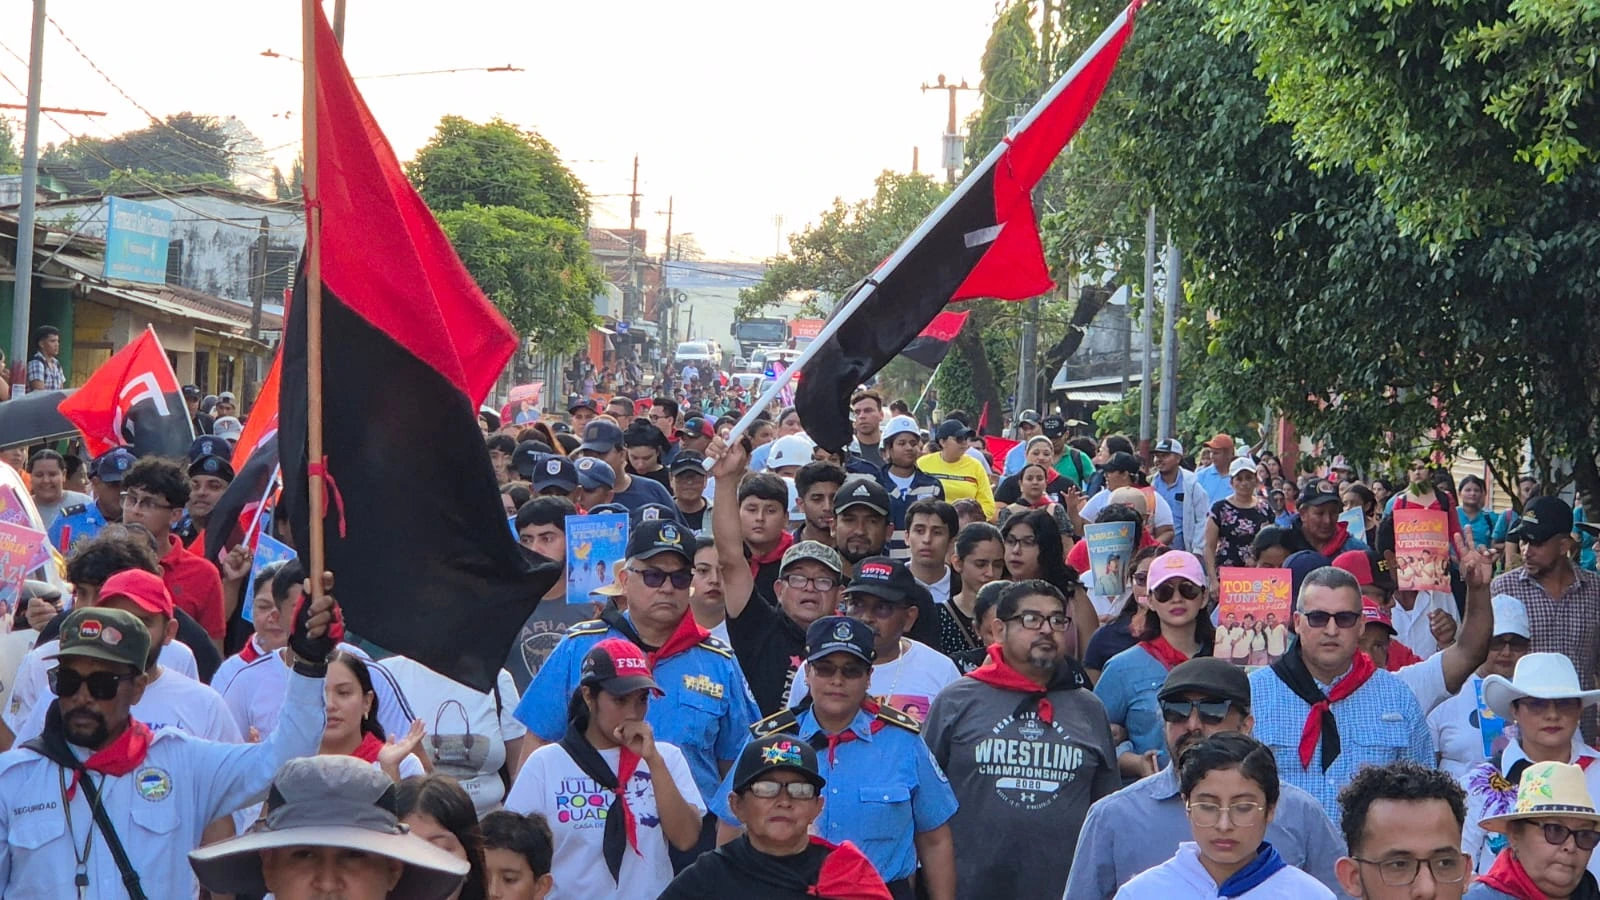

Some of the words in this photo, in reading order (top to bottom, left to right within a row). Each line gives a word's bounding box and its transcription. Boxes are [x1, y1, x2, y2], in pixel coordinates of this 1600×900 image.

[975, 738, 1083, 771] WRESTLING
[979, 764, 1076, 783] CHAMPIONSHIPS
[1015, 779, 1041, 789] 2020
[13, 801, 57, 816] SEGURIDAD
